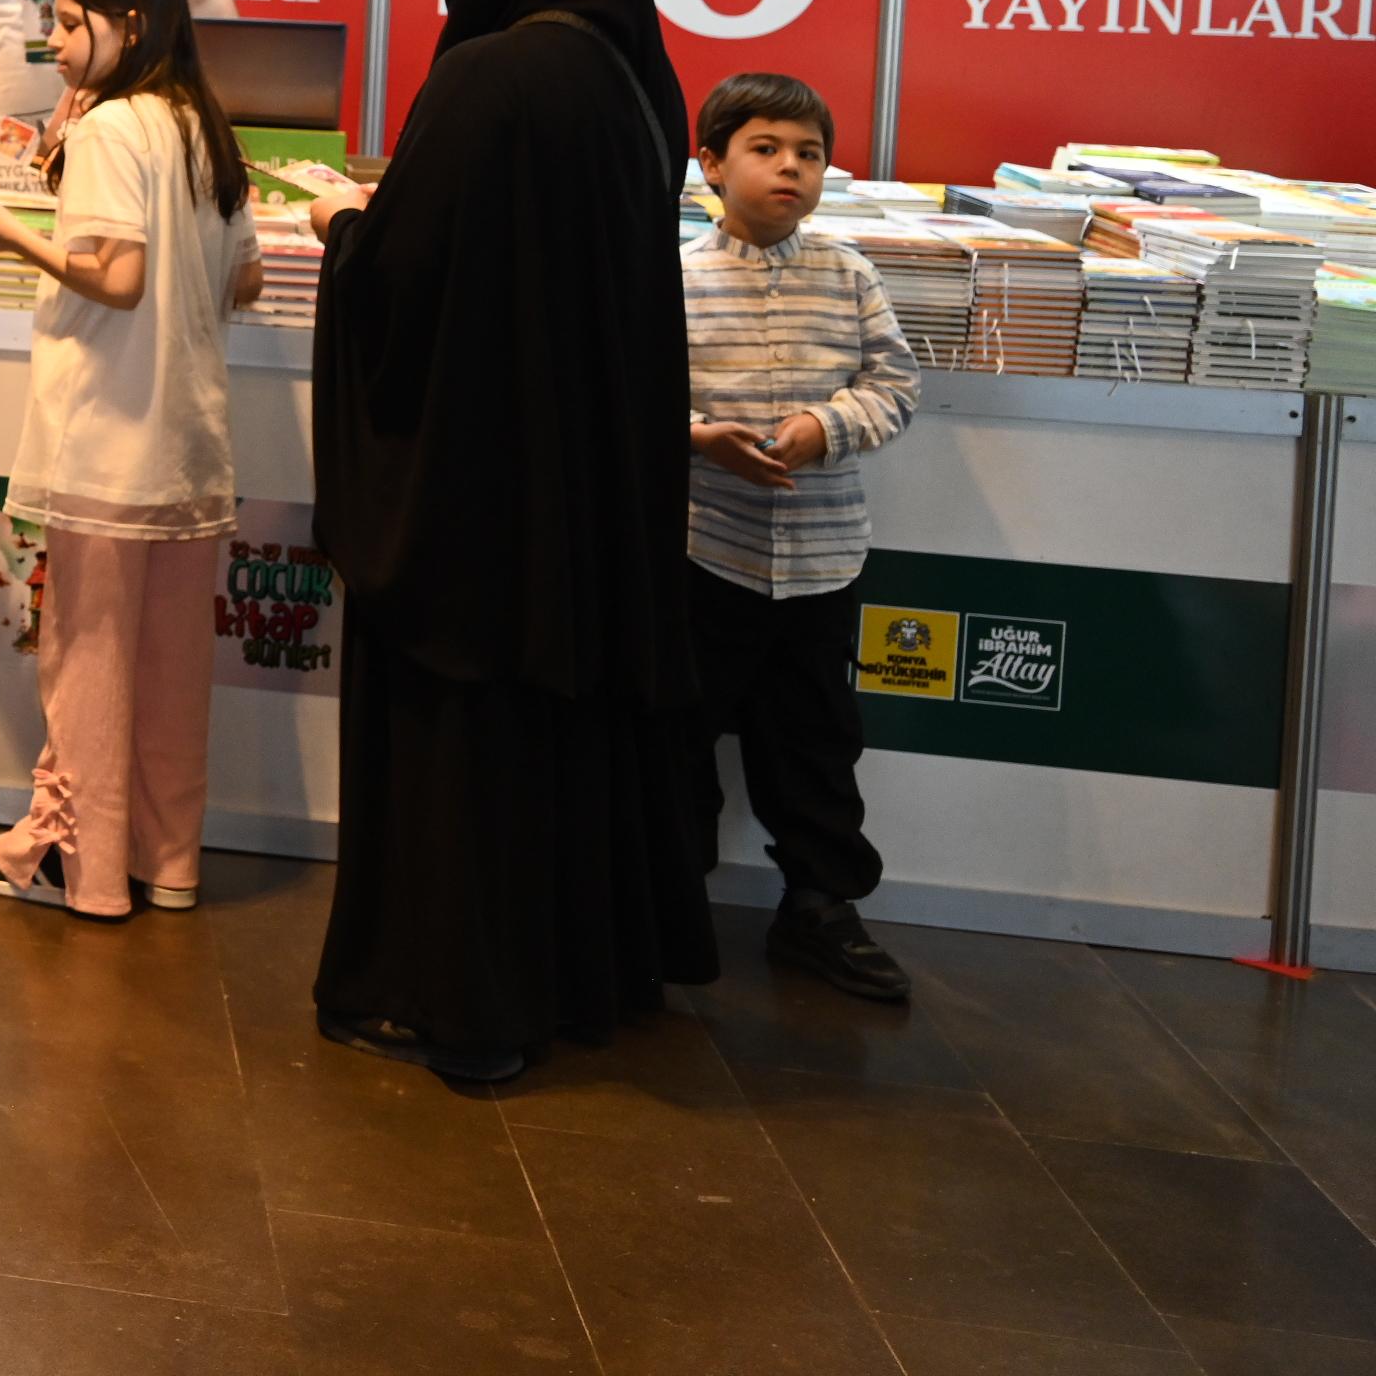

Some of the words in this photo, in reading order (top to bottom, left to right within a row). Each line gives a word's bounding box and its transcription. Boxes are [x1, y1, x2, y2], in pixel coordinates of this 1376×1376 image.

[990, 625, 1040, 643] UĞUR
[978, 638, 1052, 657] İBRAHİM
[887, 654, 927, 666] KONYA
[967, 652, 1056, 694] Altay
